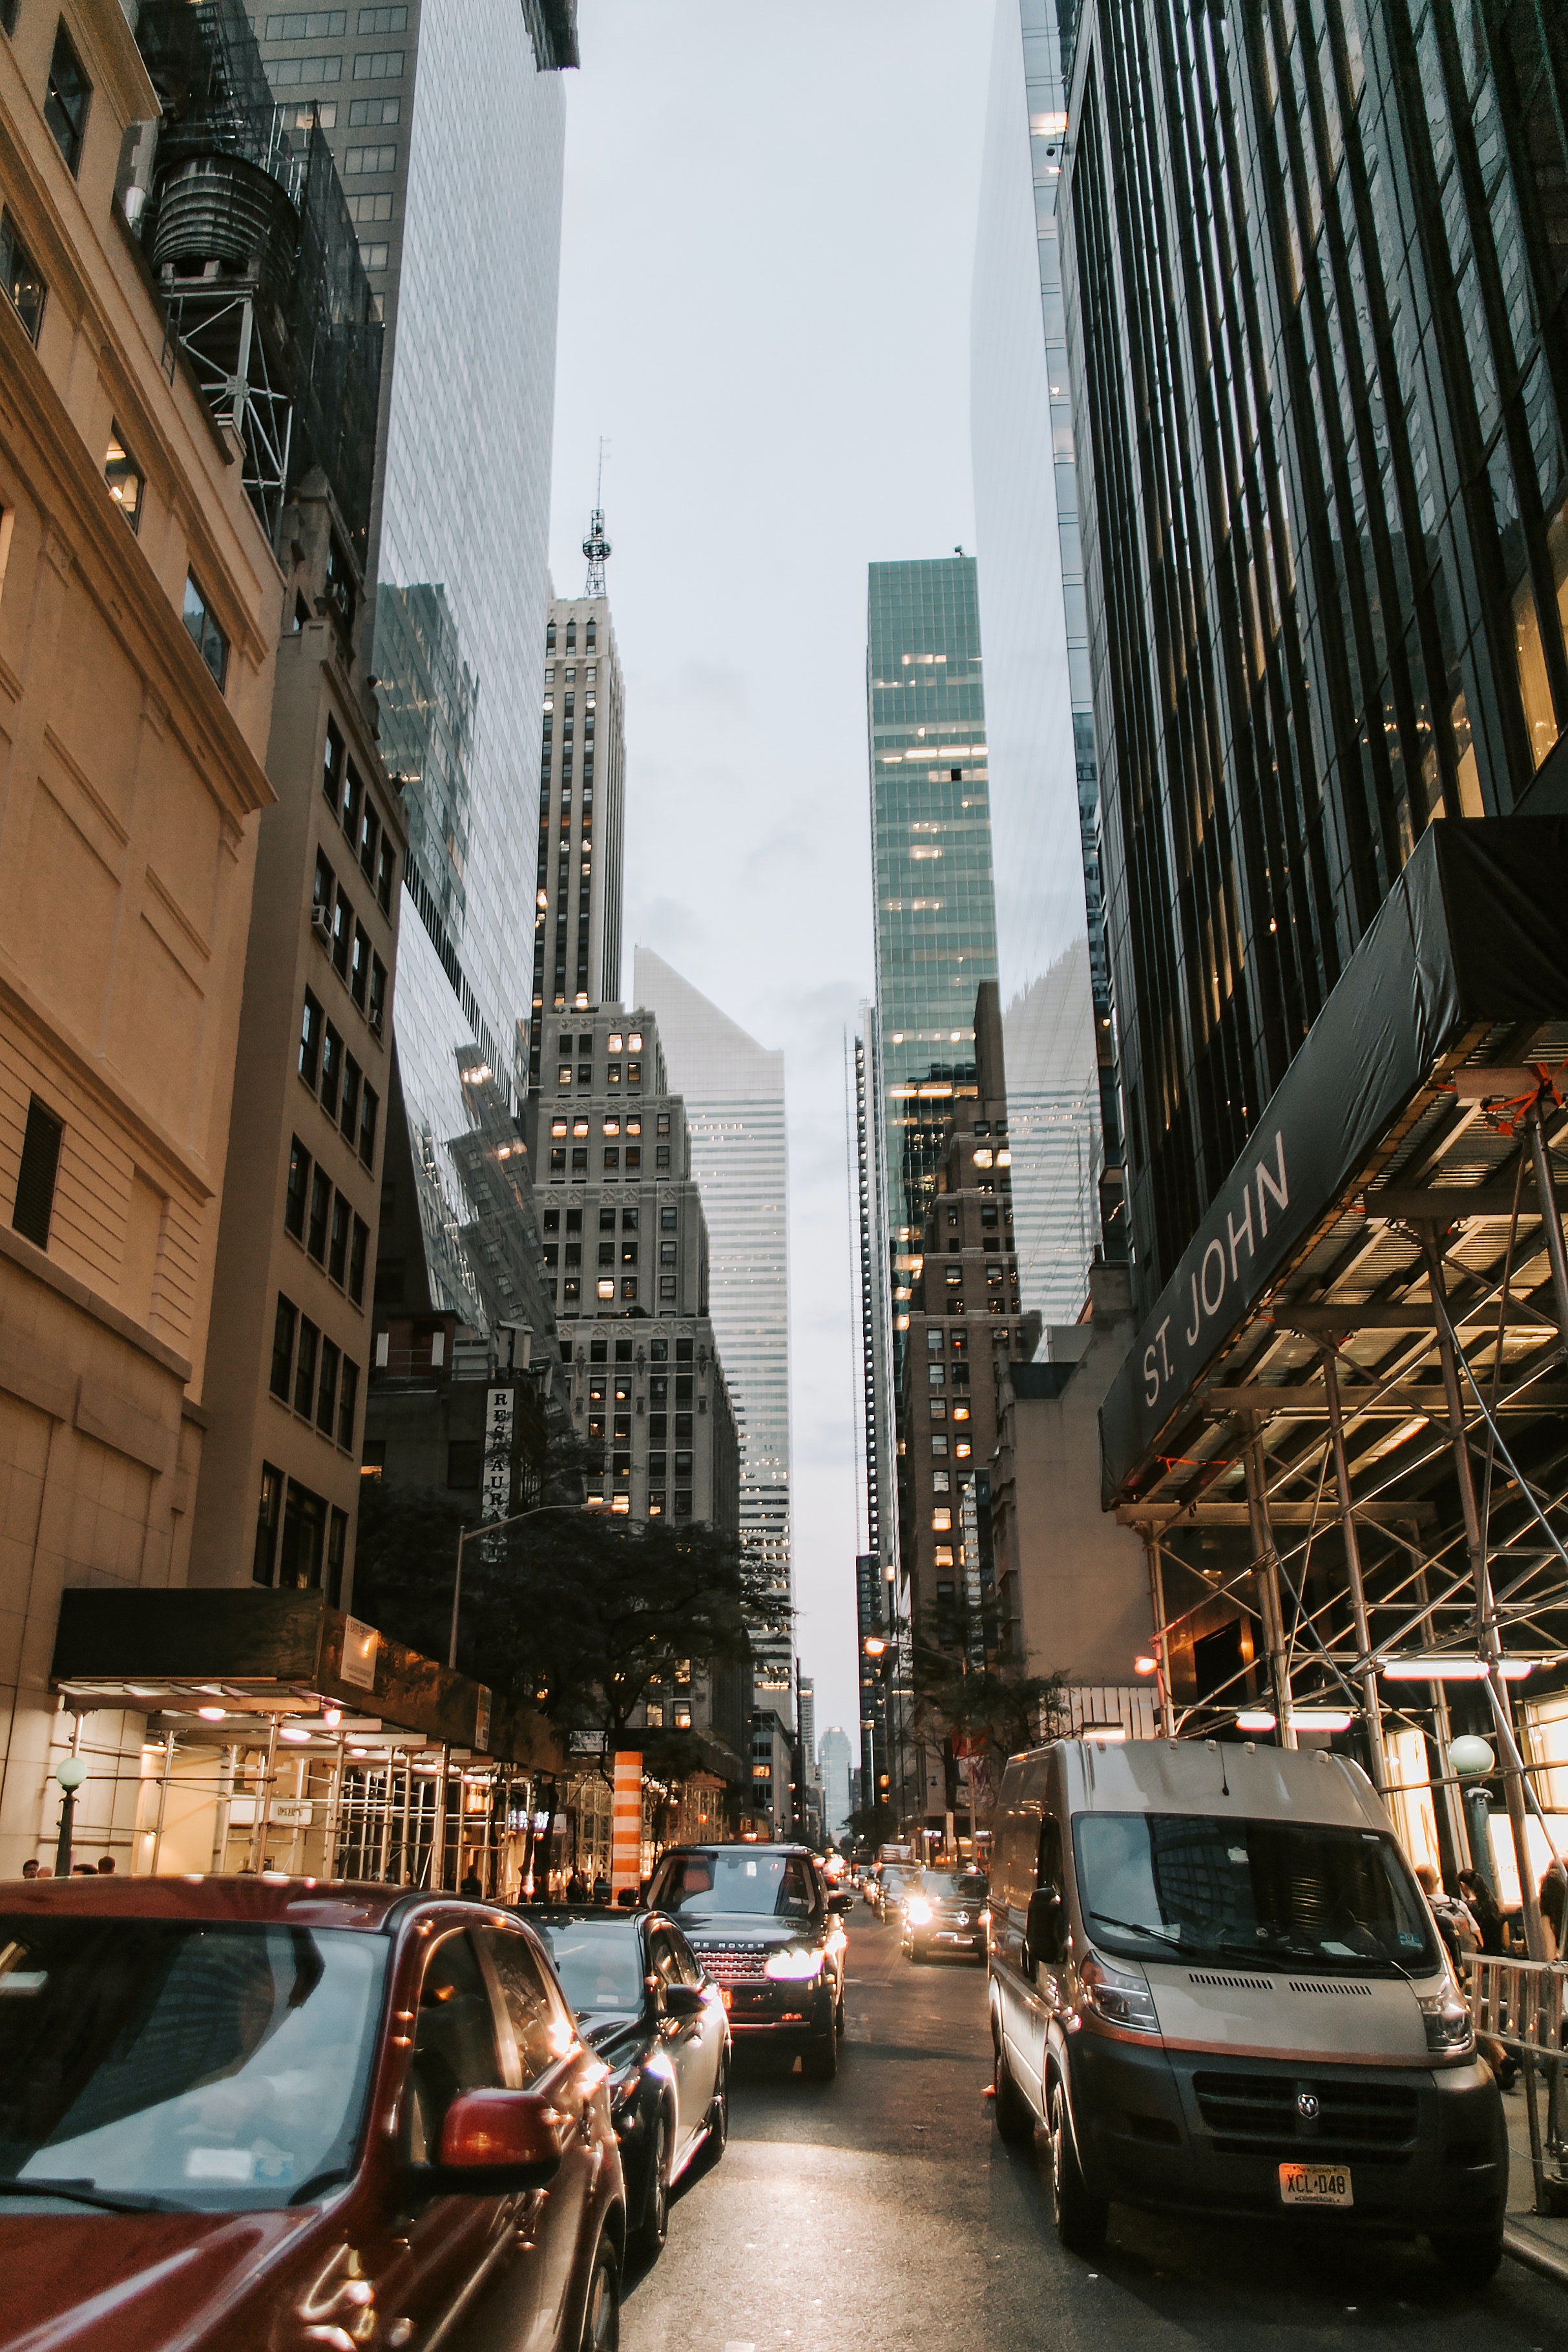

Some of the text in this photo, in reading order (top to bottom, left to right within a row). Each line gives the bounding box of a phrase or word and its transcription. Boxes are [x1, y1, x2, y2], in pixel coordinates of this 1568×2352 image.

[1144, 1129, 1290, 1407] ST. JOHN
[487, 1393, 508, 1558] RESAURA
